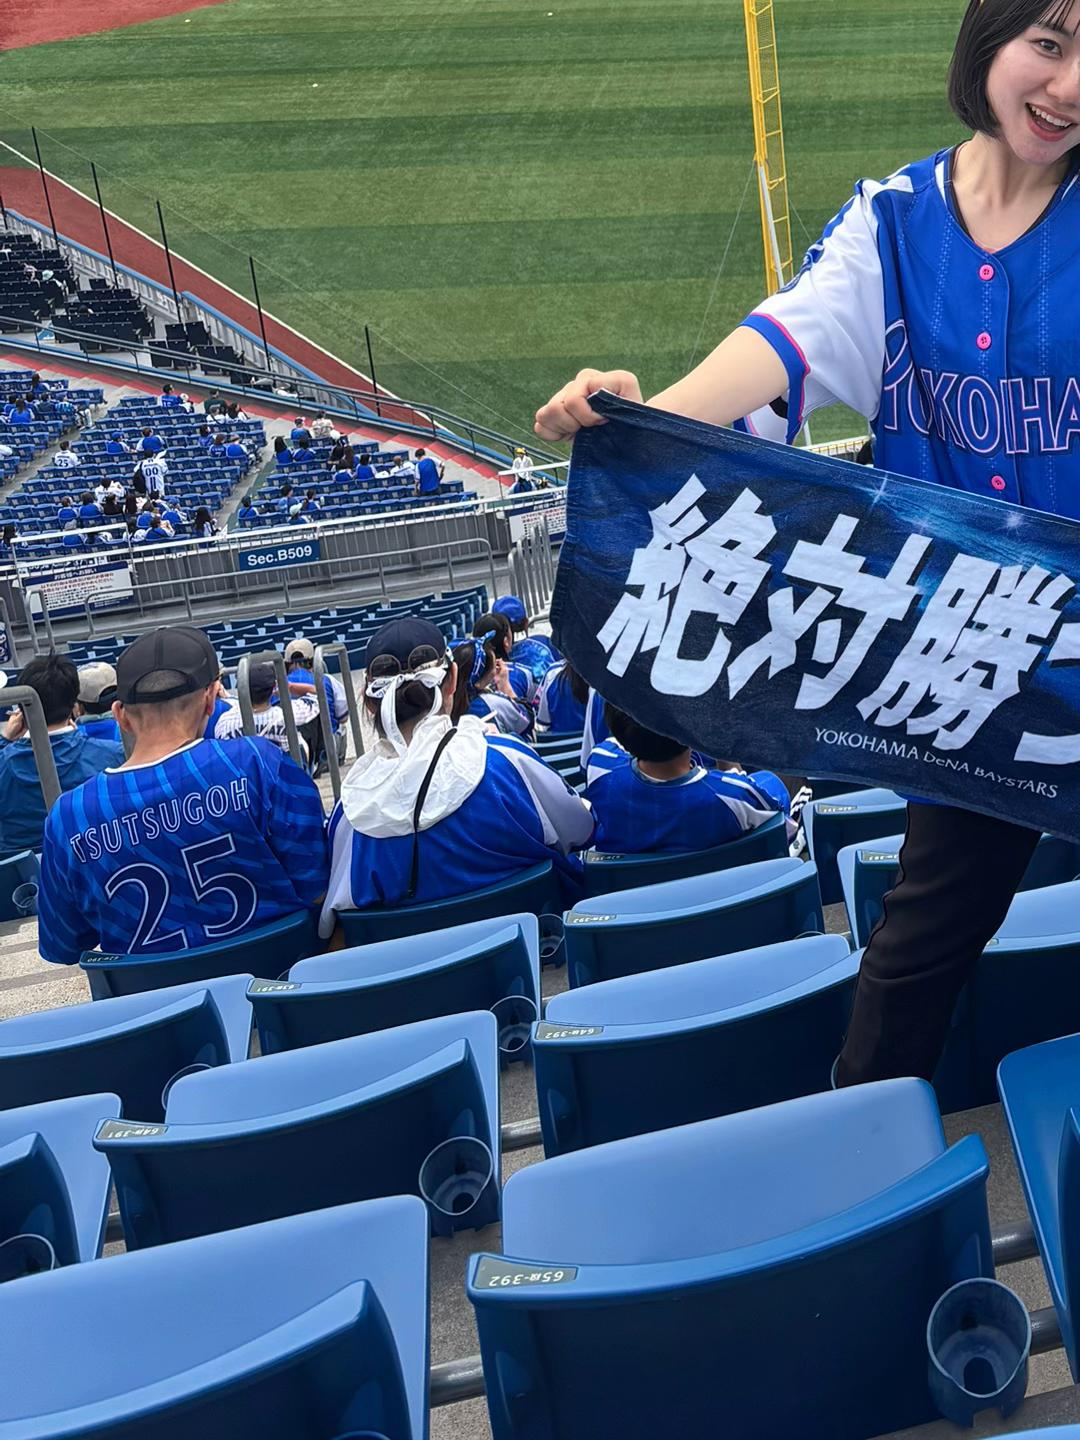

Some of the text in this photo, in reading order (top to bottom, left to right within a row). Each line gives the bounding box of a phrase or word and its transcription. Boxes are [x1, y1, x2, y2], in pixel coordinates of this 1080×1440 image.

[145, 467, 158, 477] 00
[247, 545, 313, 567] Sec.B509
[815, 727, 1059, 799] YOKOHAMA DeNA BAYSTARS
[70, 777, 250, 864] TSUTSUGOH
[105, 833, 258, 955] 25
[489, 1271, 564, 1286] 65段-392
